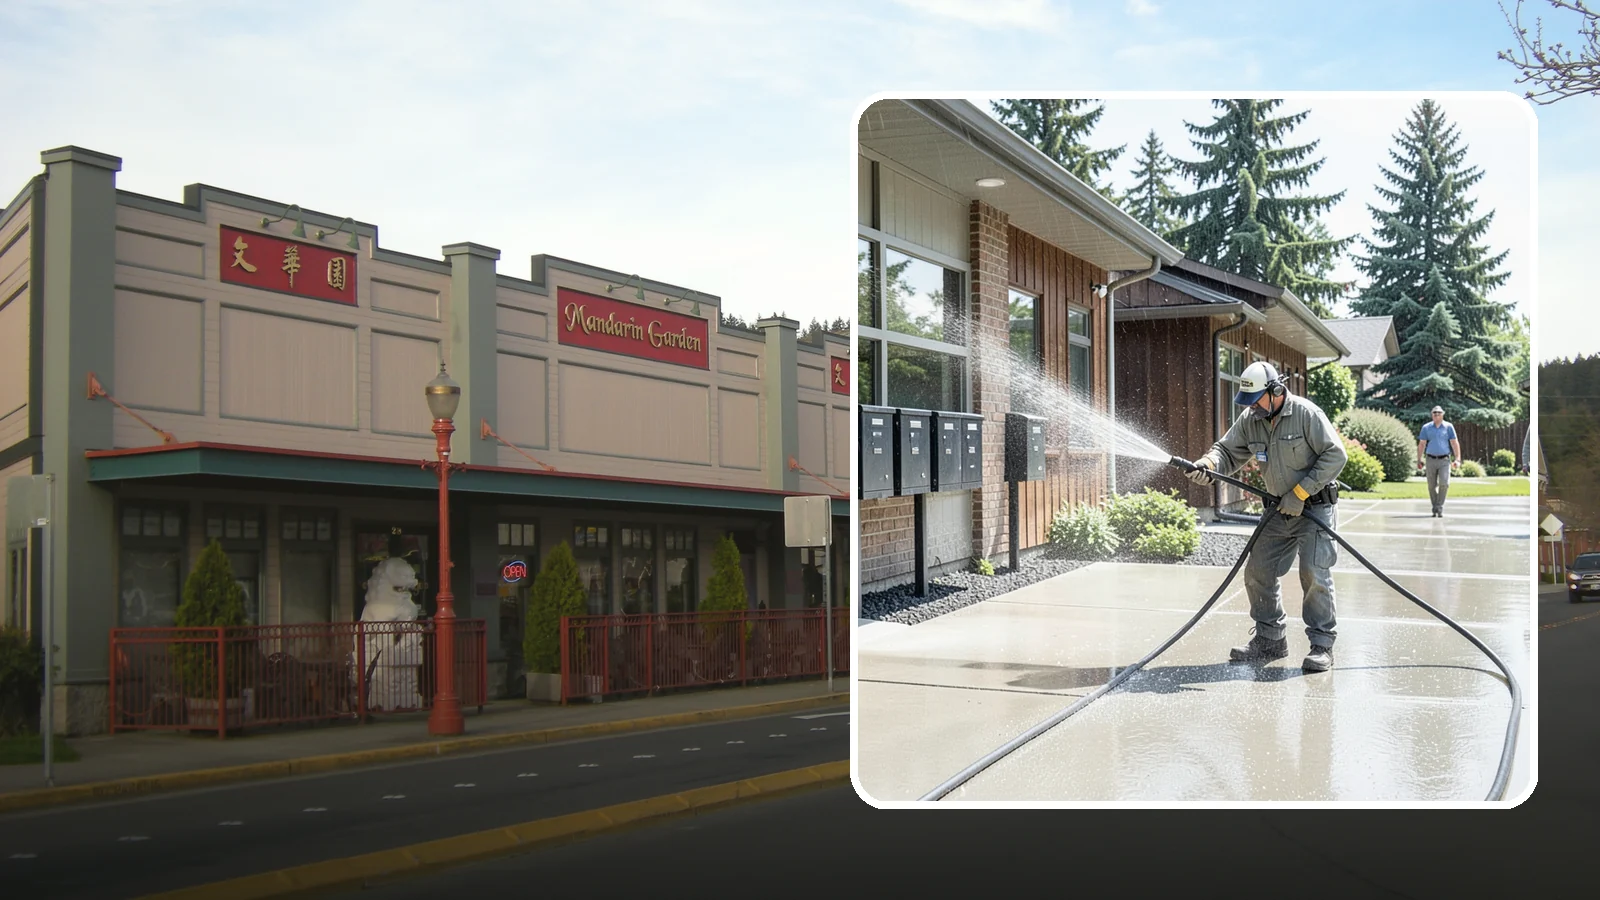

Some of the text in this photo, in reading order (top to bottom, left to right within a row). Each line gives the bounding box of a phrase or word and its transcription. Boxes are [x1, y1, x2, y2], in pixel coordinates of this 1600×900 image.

[231, 236, 346, 291] 文華園
[564, 302, 701, 352] Mandarin Garden
[503, 565, 527, 578] OPEN
